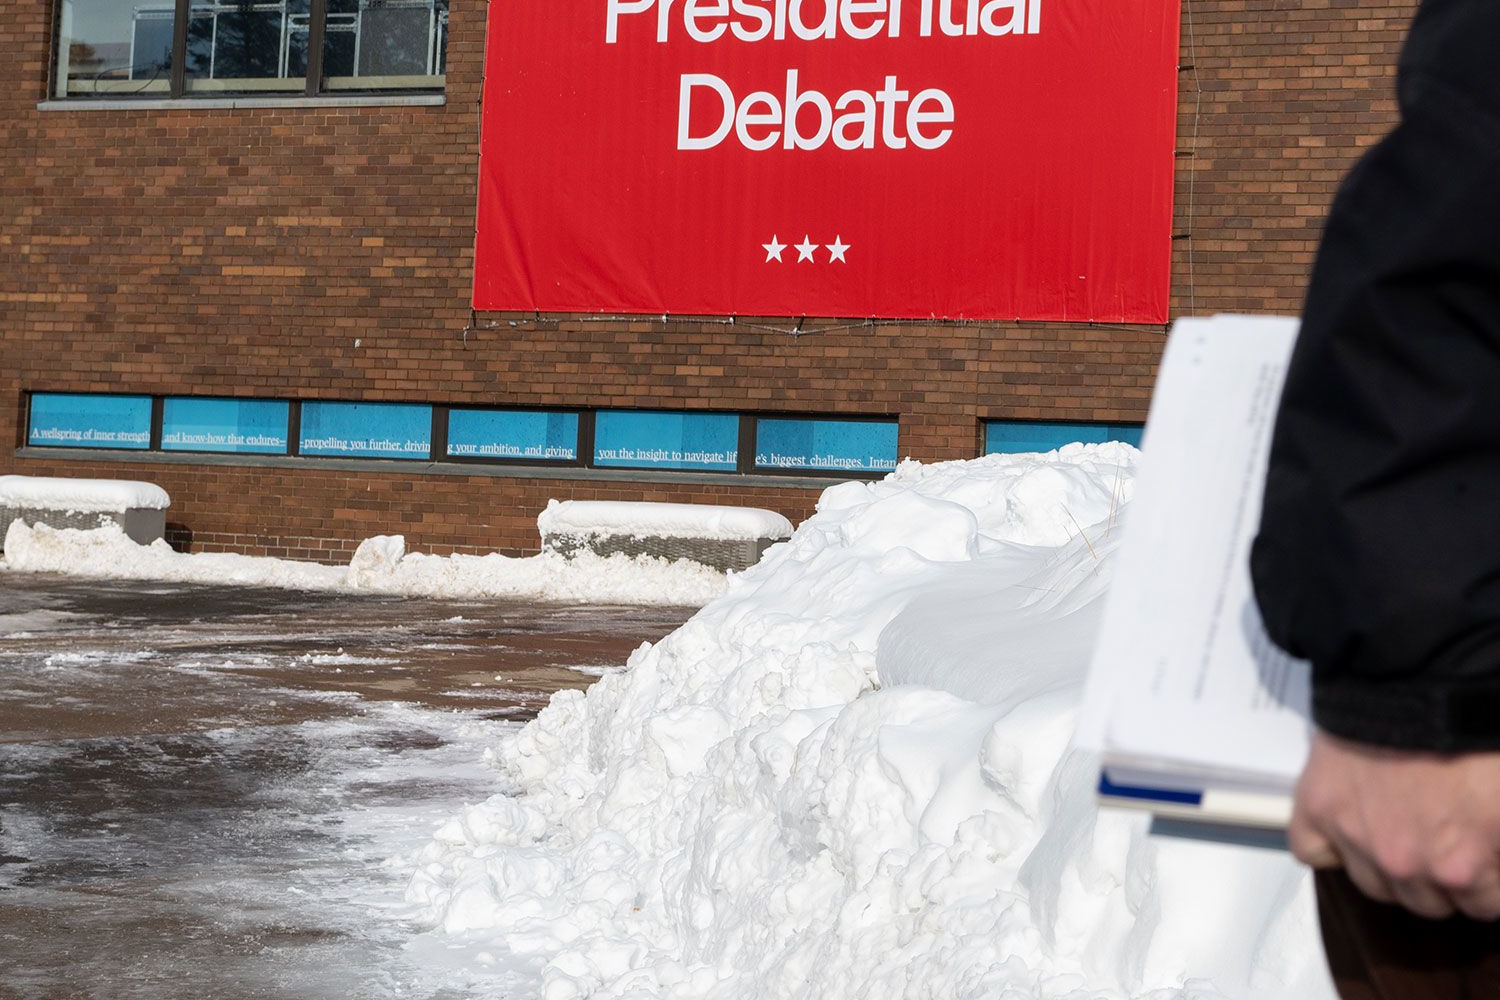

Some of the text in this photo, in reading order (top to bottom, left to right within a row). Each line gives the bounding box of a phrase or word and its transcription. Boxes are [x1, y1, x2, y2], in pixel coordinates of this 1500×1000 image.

[676, 69, 955, 151] Debate
[31, 427, 150, 443] A wellspring of inner strength
[164, 432, 180, 443] and
[182, 432, 225, 444] know-how
[227, 433, 245, 445] that
[350, 440, 366, 451] you
[456, 443, 477, 455] your
[525, 445, 541, 456] and
[545, 446, 573, 459] giving
[599, 449, 616, 460] you
[619, 448, 634, 459] the
[636, 449, 668, 462] insight
[672, 450, 682, 460] to
[684, 451, 724, 464] navigate
[771, 453, 806, 467] biggest
